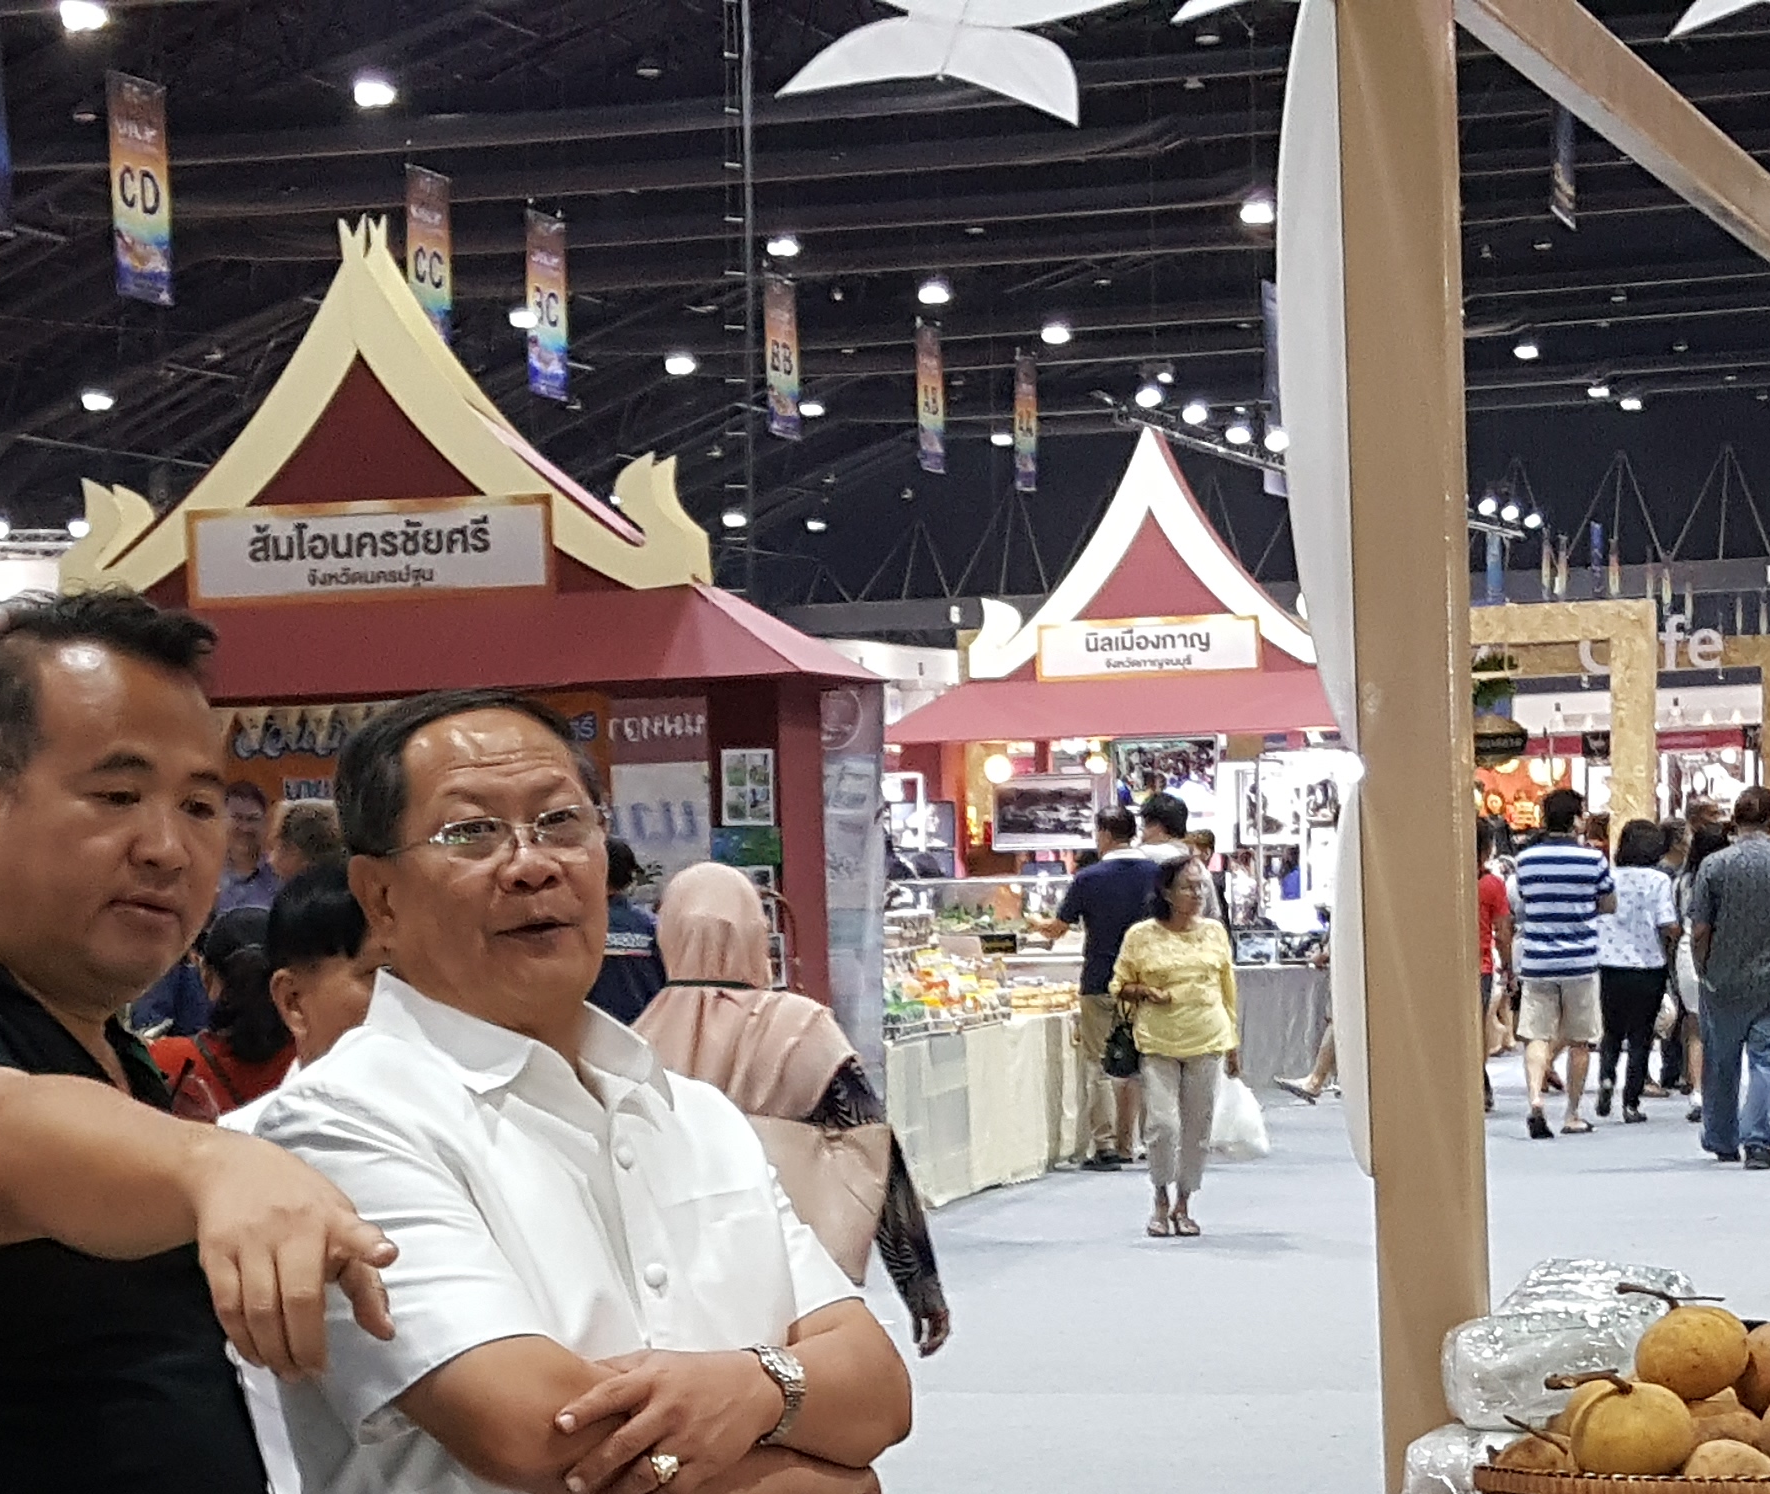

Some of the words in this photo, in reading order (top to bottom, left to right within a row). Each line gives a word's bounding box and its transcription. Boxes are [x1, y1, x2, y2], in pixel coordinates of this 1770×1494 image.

[119, 164, 160, 215] CD
[414, 245, 444, 289] CC
[247, 514, 492, 564] ส้มโอนครชัยศรี
[1084, 627, 1211, 653] นิลเมืองกาญ
